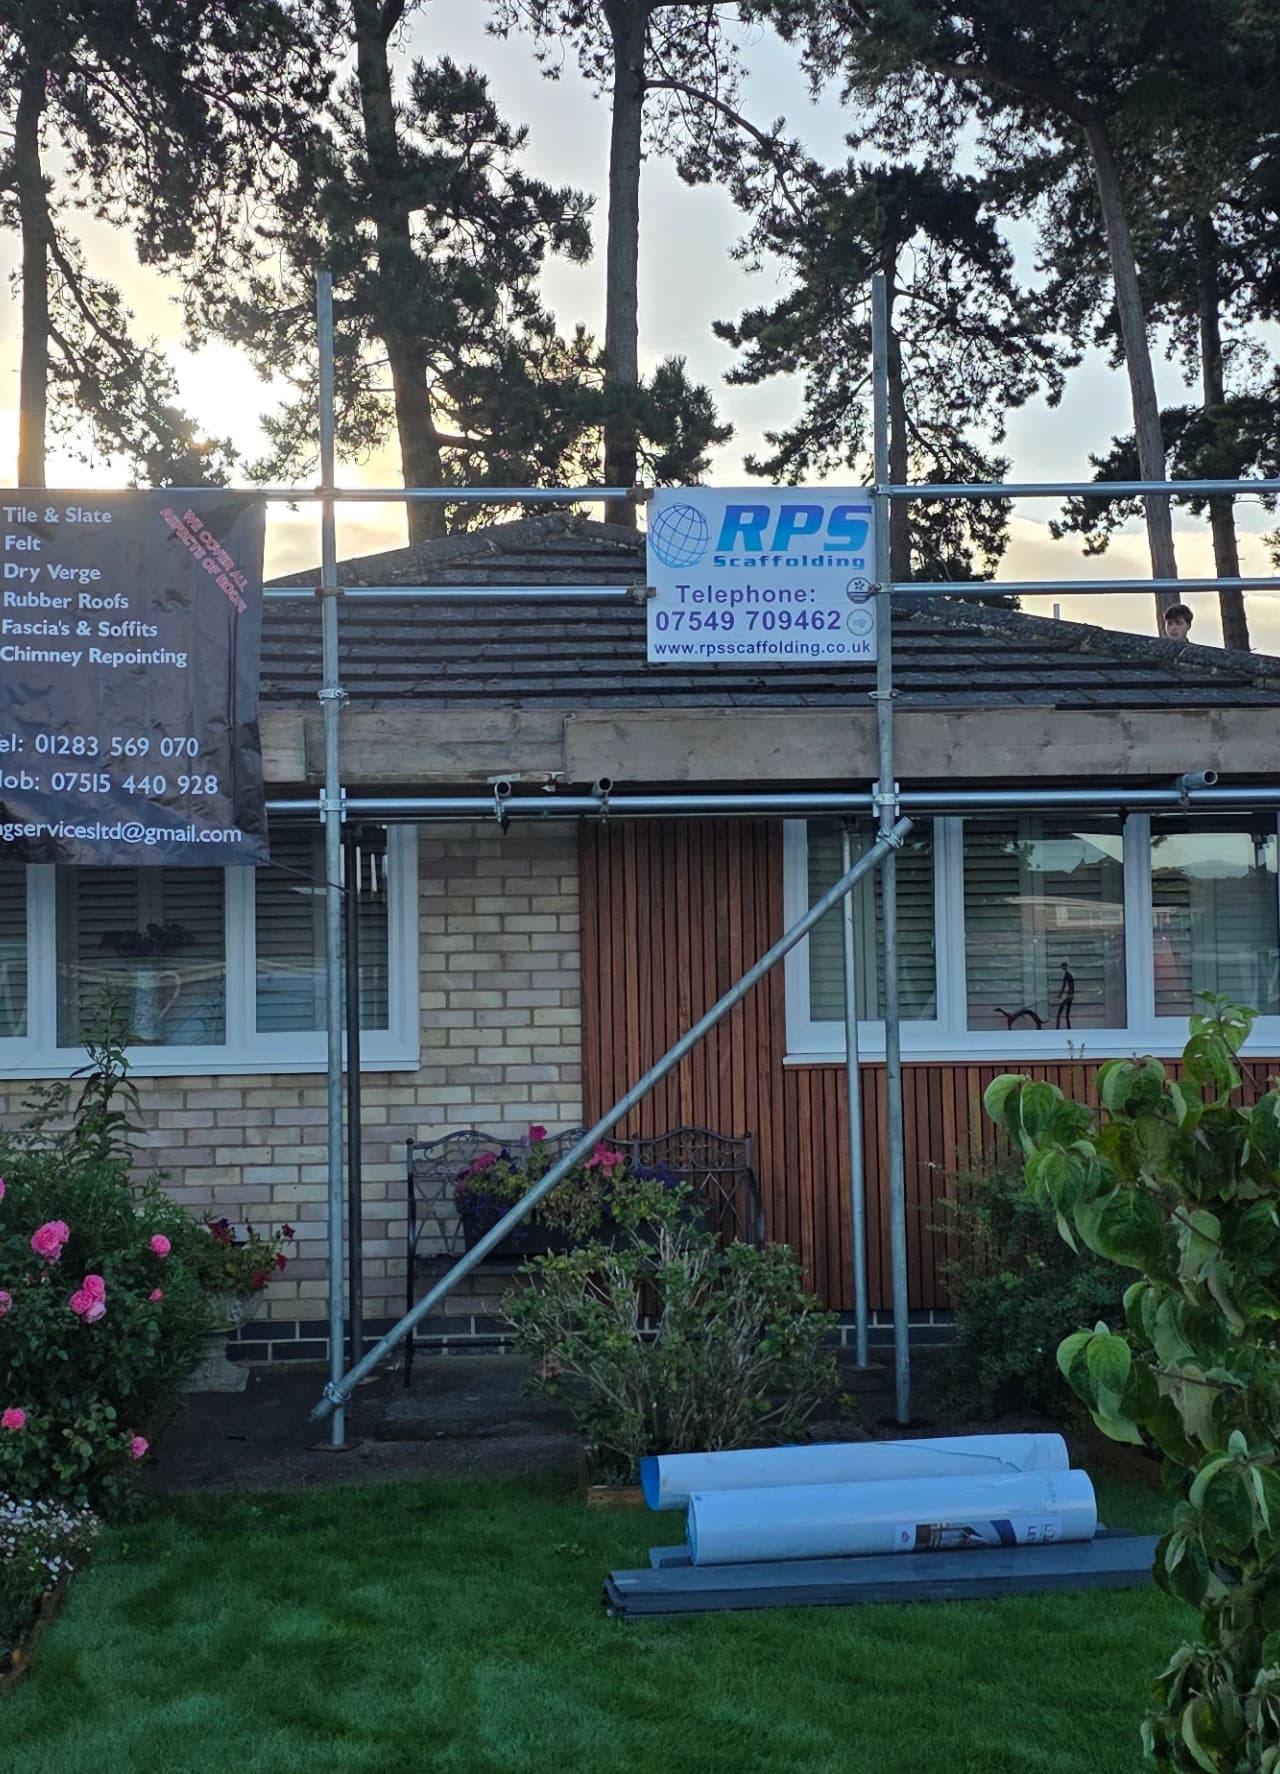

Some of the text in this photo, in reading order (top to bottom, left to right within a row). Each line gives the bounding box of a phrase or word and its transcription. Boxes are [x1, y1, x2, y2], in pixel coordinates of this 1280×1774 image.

[3, 506, 113, 524] Tile & Slate
[716, 504, 872, 552] RPS
[4, 535, 41, 551] Felt
[713, 555, 865, 570] Scaffolding
[3, 563, 102, 584] Dry Verge
[3, 591, 129, 609] Rubber Roofs
[675, 585, 816, 607] Telephone:
[1, 619, 158, 637] Fascia's & Soffits
[655, 610, 841, 631] 07549 709462
[0, 646, 188, 668] Chimney Repointing
[654, 640, 870, 657] www.rpsscaffolding.co.uk
[35, 734, 99, 756] 01283
[110, 737, 150, 757] 569
[160, 737, 199, 757] 070
[51, 772, 111, 793] 07515
[122, 775, 166, 794] 440
[177, 775, 218, 795] 928
